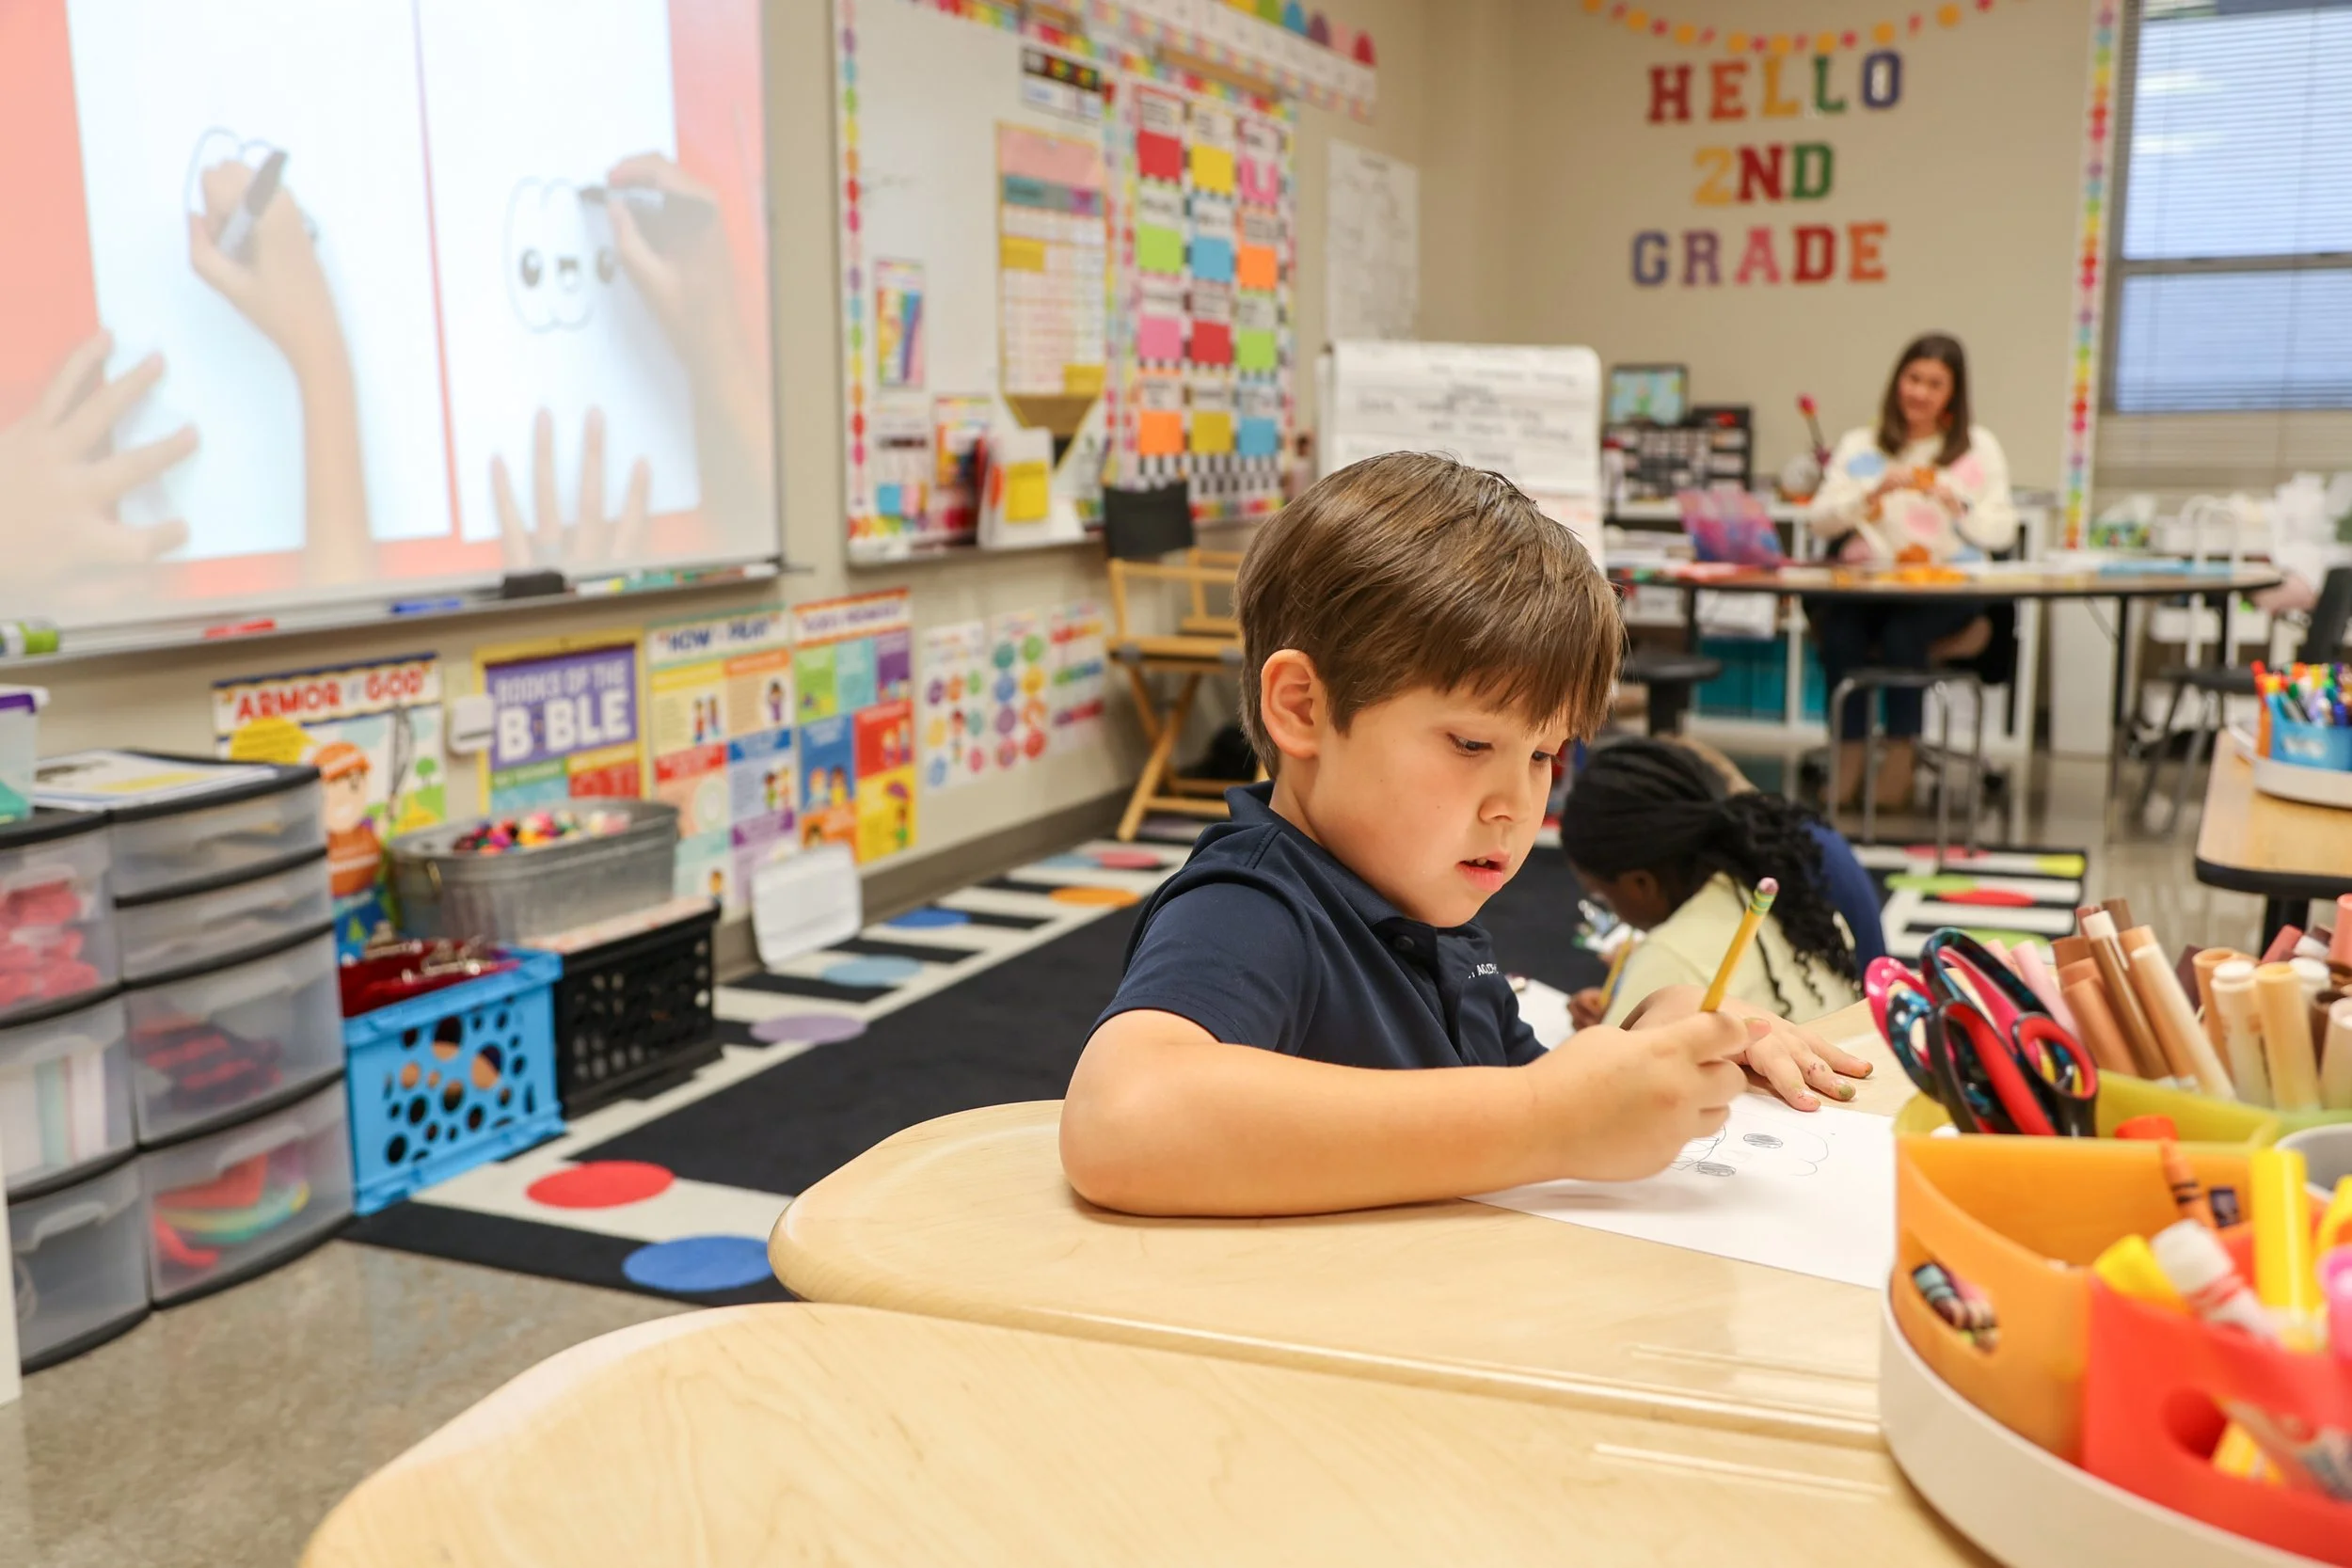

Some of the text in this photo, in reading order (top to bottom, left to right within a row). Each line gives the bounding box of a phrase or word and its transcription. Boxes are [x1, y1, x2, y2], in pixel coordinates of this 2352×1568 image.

[1646, 49, 1903, 124] HELLO
[1692, 141, 1835, 206] 2ND
[1631, 221, 1889, 288] GRADE
[237, 680, 342, 721] ARMOR
[365, 668, 424, 701] GOD
[496, 670, 561, 705] BOOKS
[498, 689, 631, 763] BBLE
